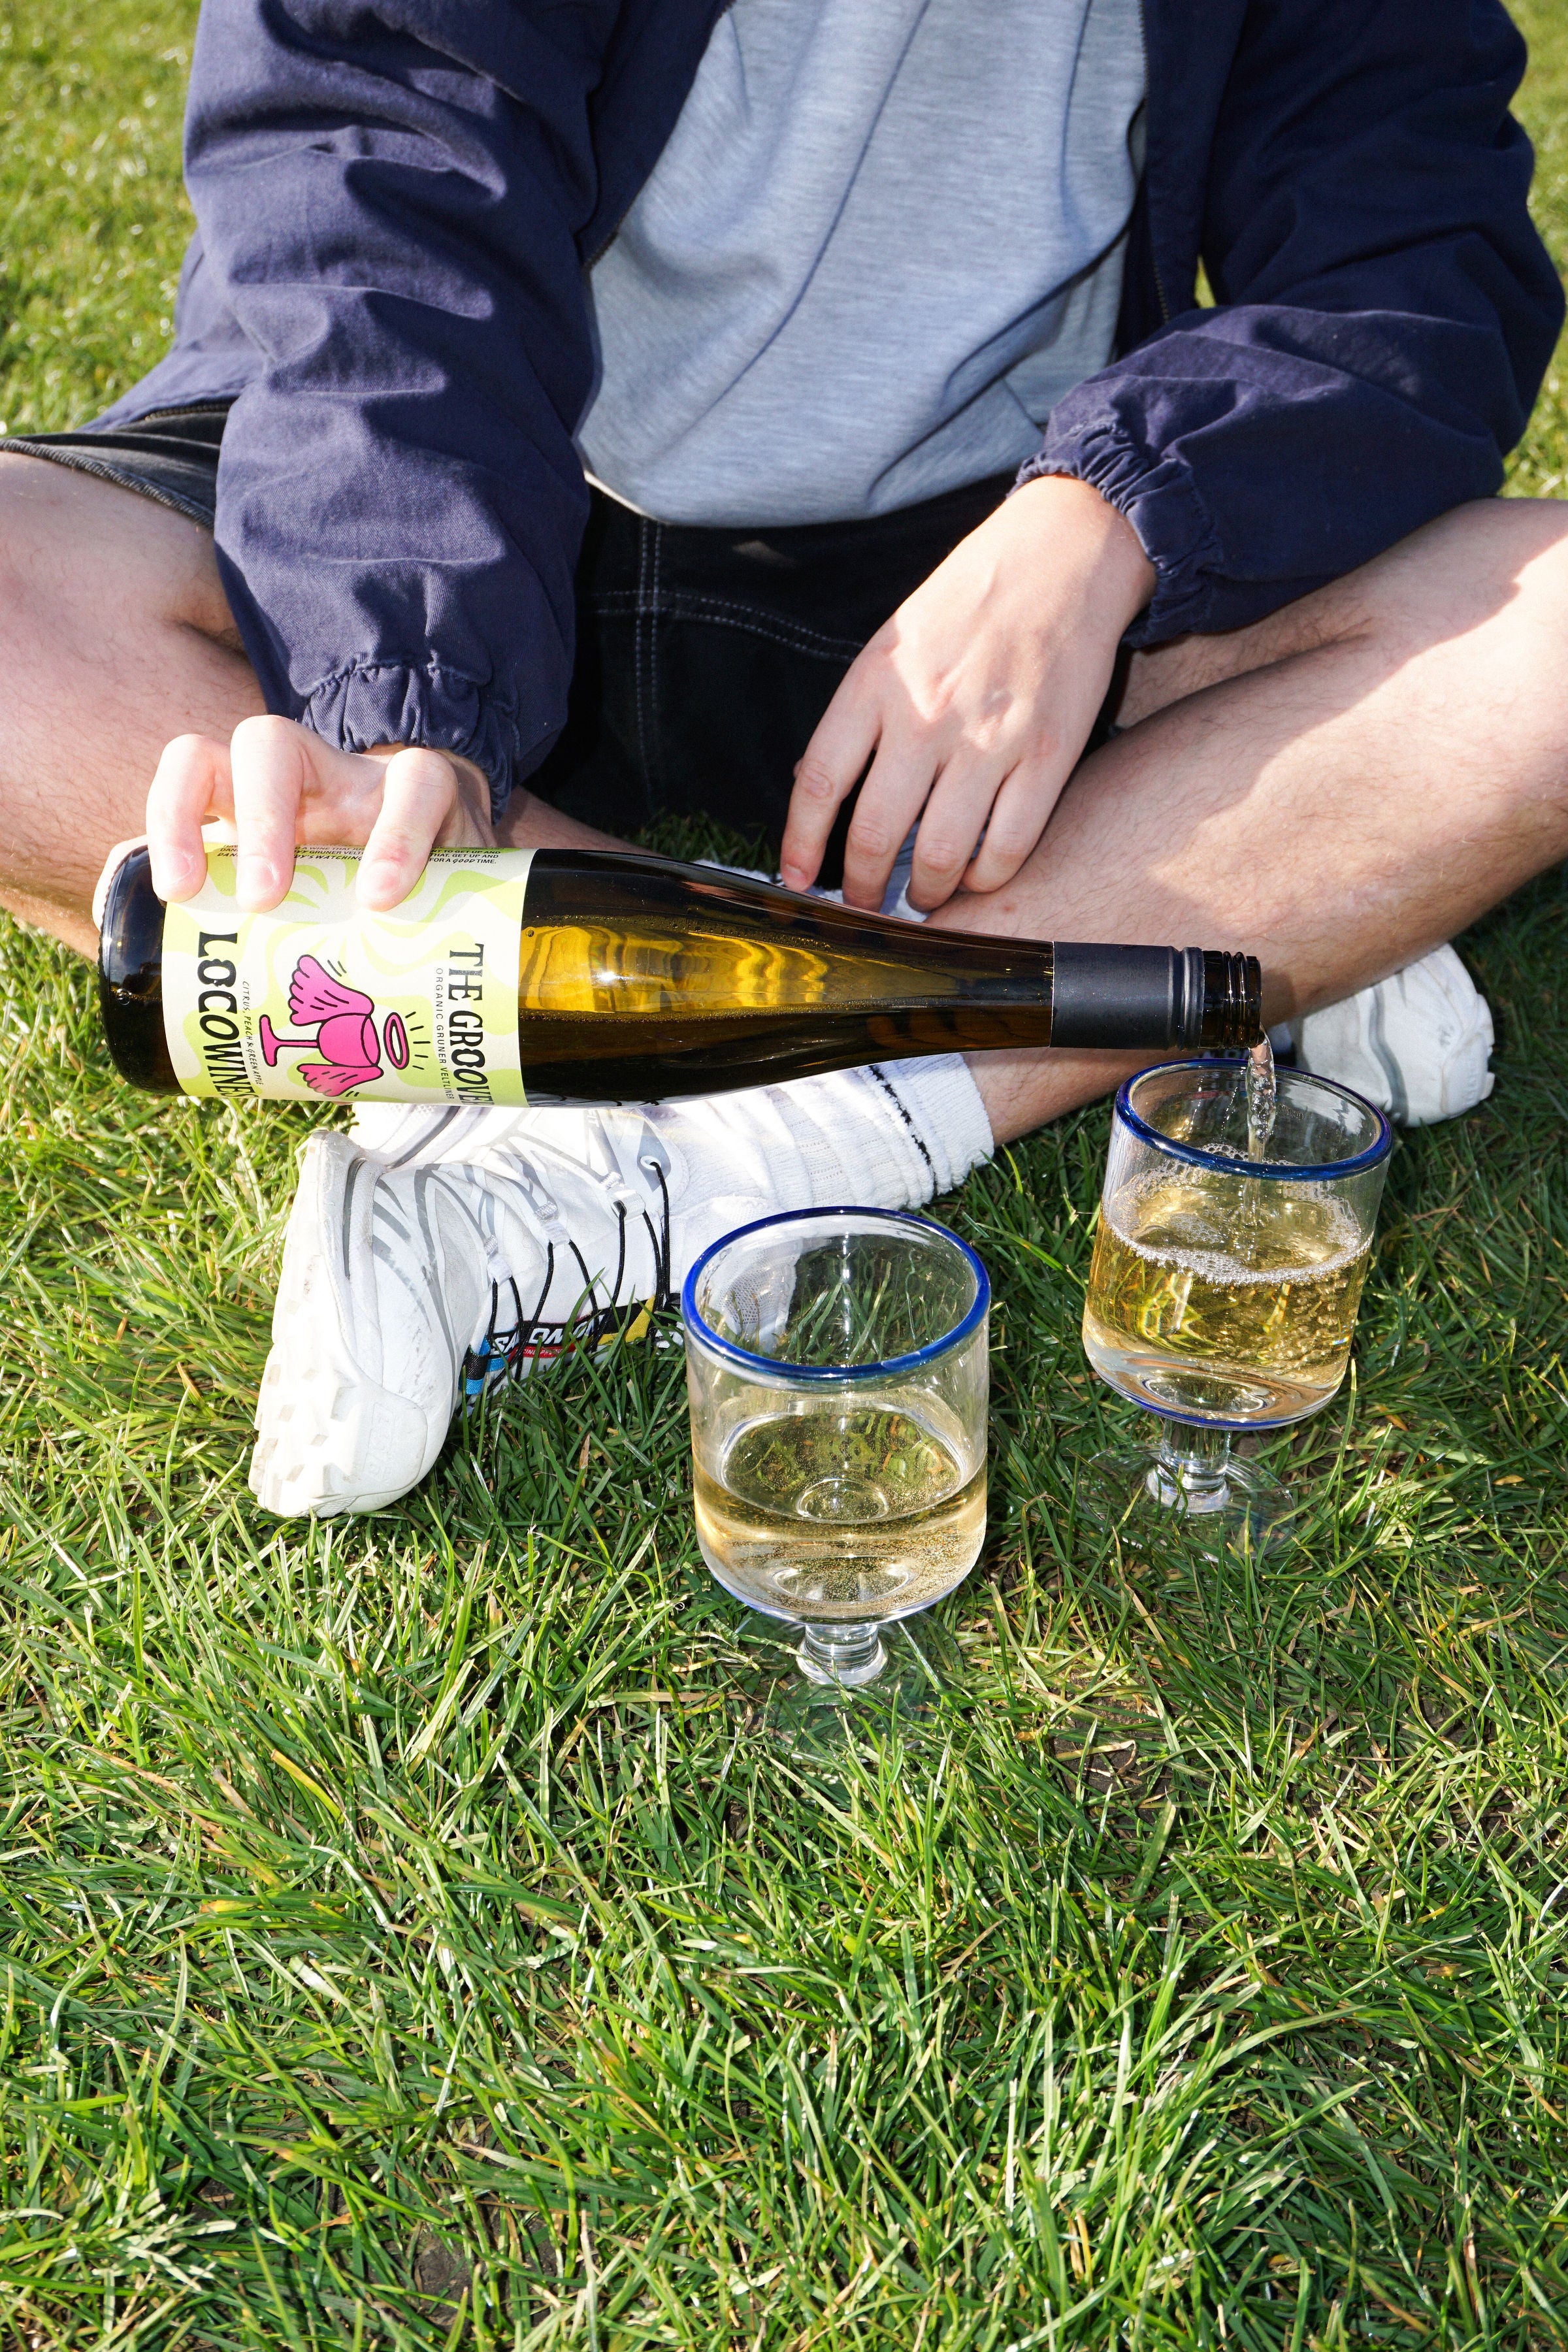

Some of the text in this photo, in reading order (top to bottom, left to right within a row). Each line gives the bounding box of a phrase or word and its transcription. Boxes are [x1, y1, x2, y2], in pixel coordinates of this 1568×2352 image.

[448, 943, 485, 1001] THE
[242, 981, 251, 1013] CITRUS,
[244, 1016, 253, 1041] PEACH
[435, 968, 455, 1100] ORGANIC GRUNER VELTLINER
[248, 1047, 259, 1070] GREEN
[253, 1070, 264, 1085] APPLE
[490, 1313, 605, 1356] SAOMON
